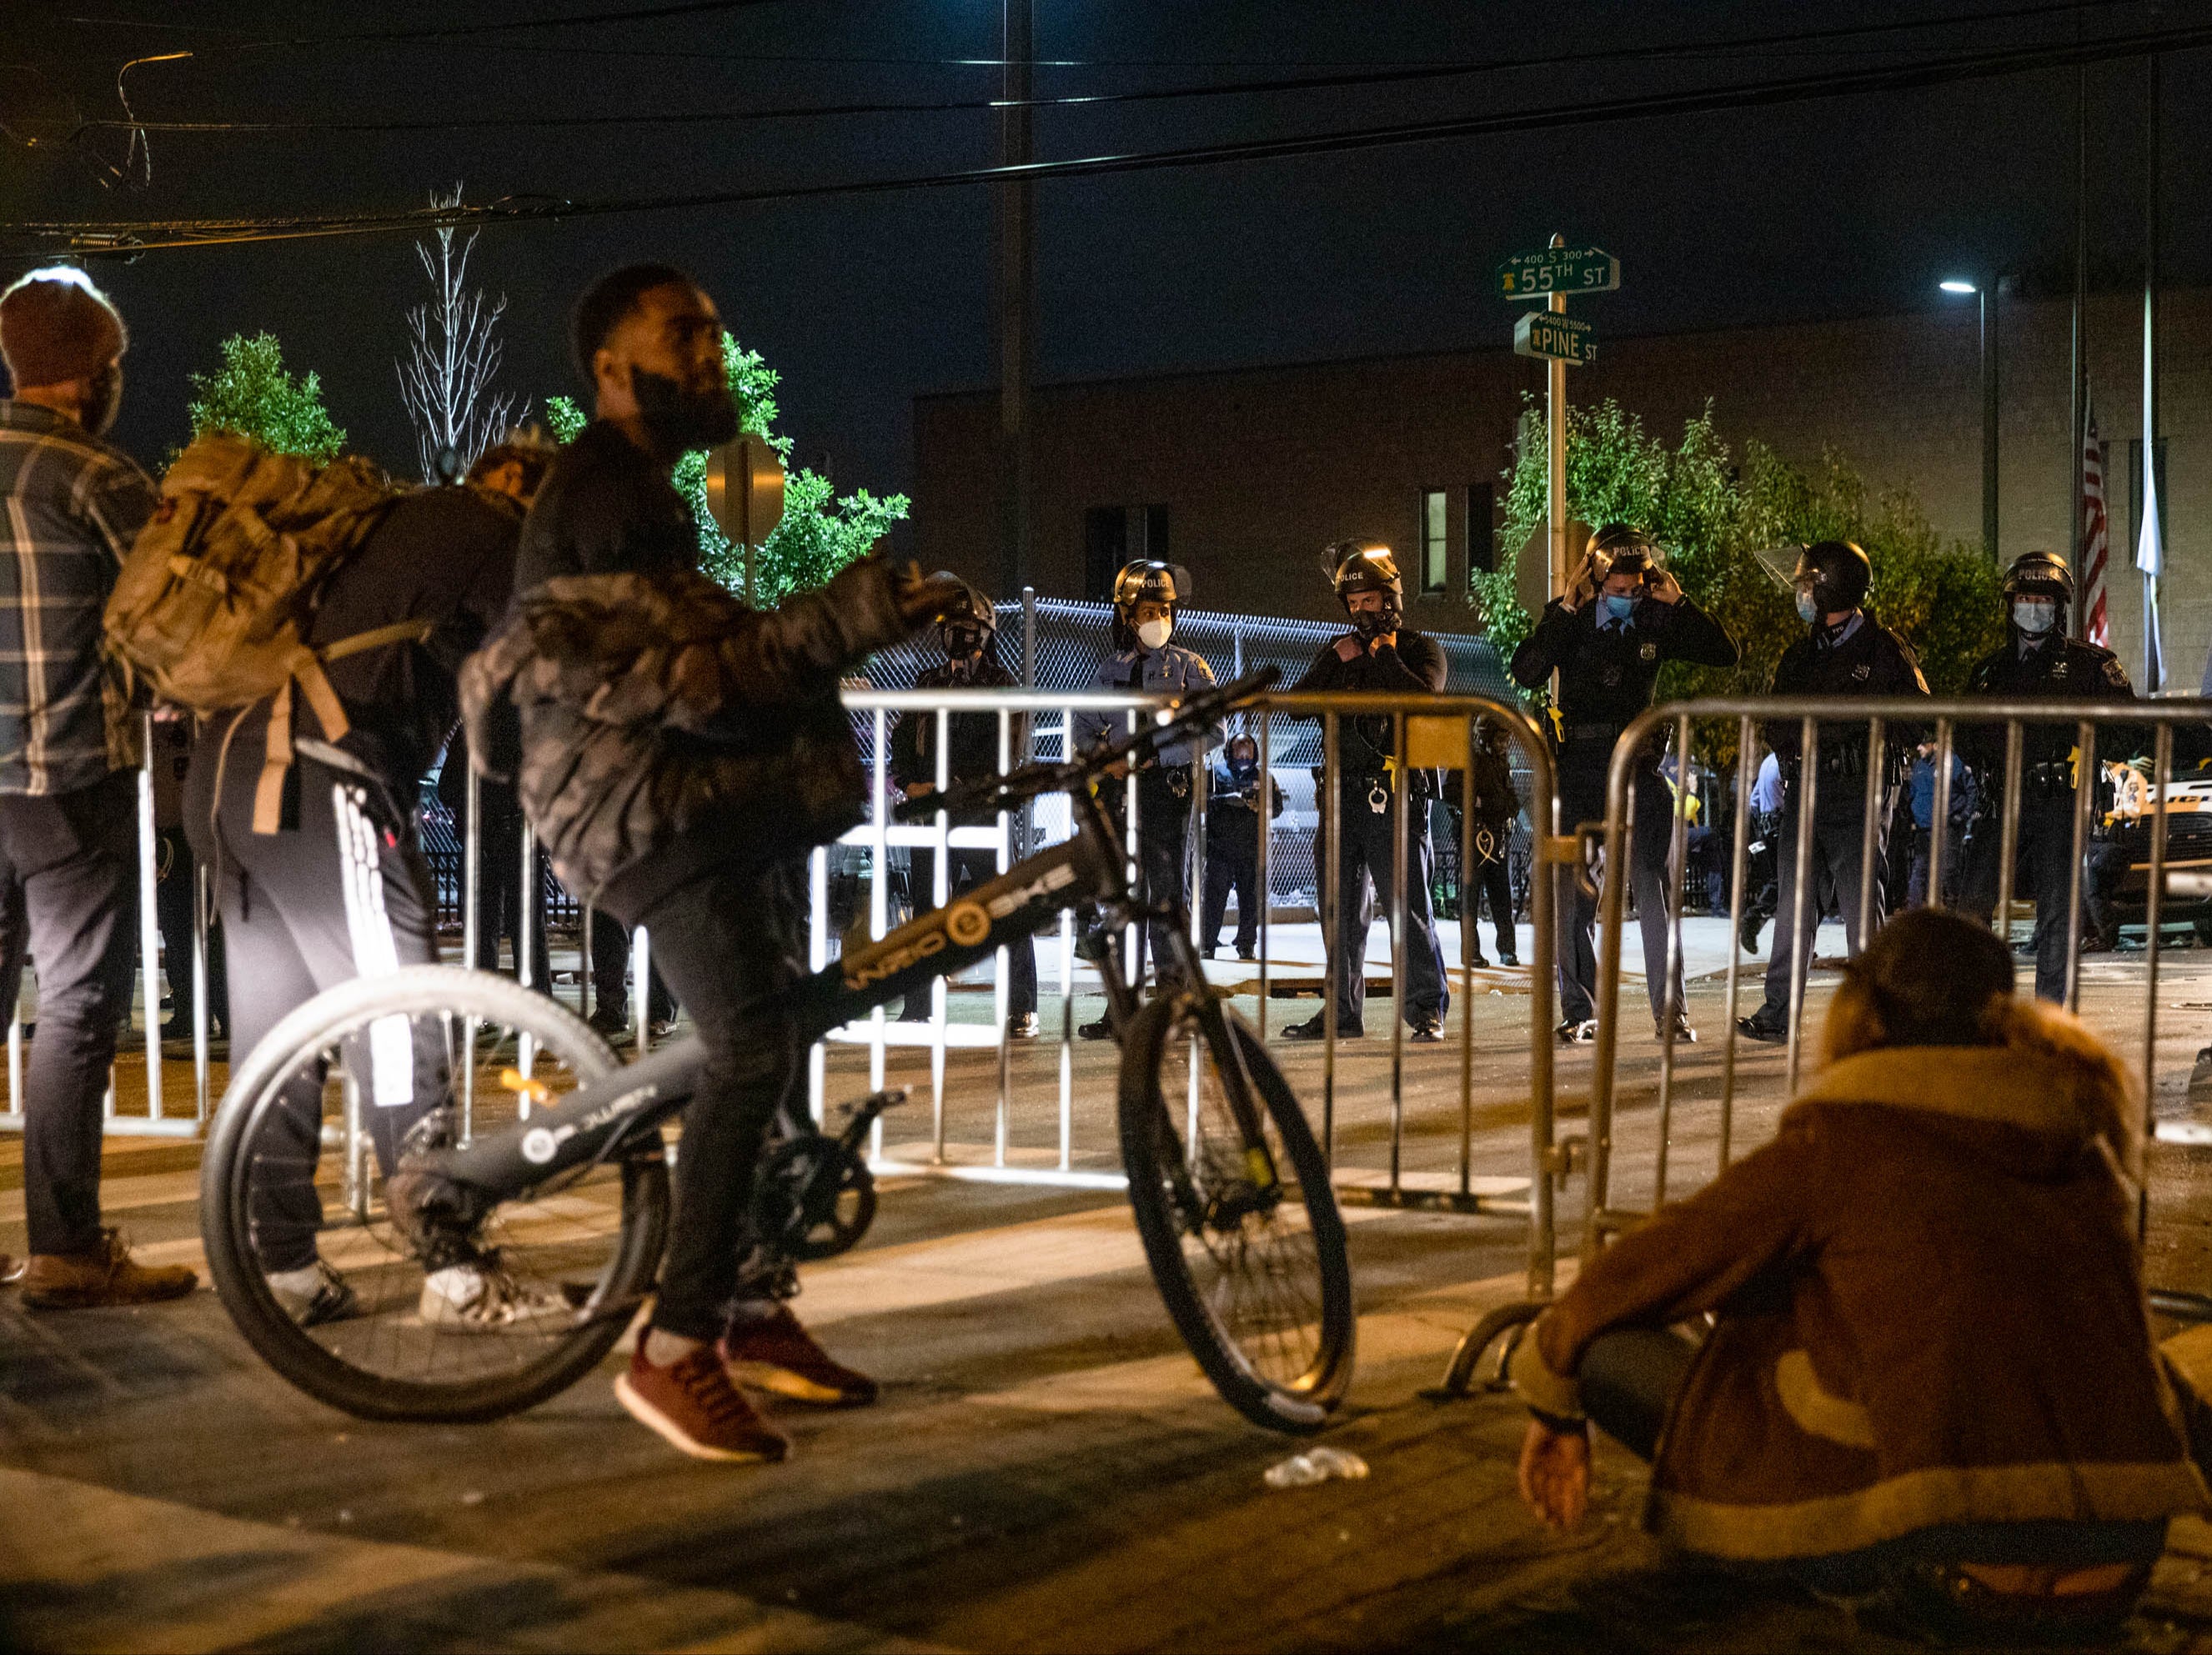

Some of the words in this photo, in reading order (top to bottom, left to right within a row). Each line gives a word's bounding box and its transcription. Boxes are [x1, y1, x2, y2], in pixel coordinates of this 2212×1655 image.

[1523, 254, 1544, 265] 400
[1548, 251, 1557, 263] S
[1562, 250, 1583, 261] 300
[1583, 267, 1605, 285] ST
[1542, 328, 1579, 358] PINE
[1585, 344, 1598, 363] ST
[1613, 545, 1642, 557] POLIC
[1339, 571, 1364, 582] OLICE
[1141, 578, 1171, 589] POLICE
